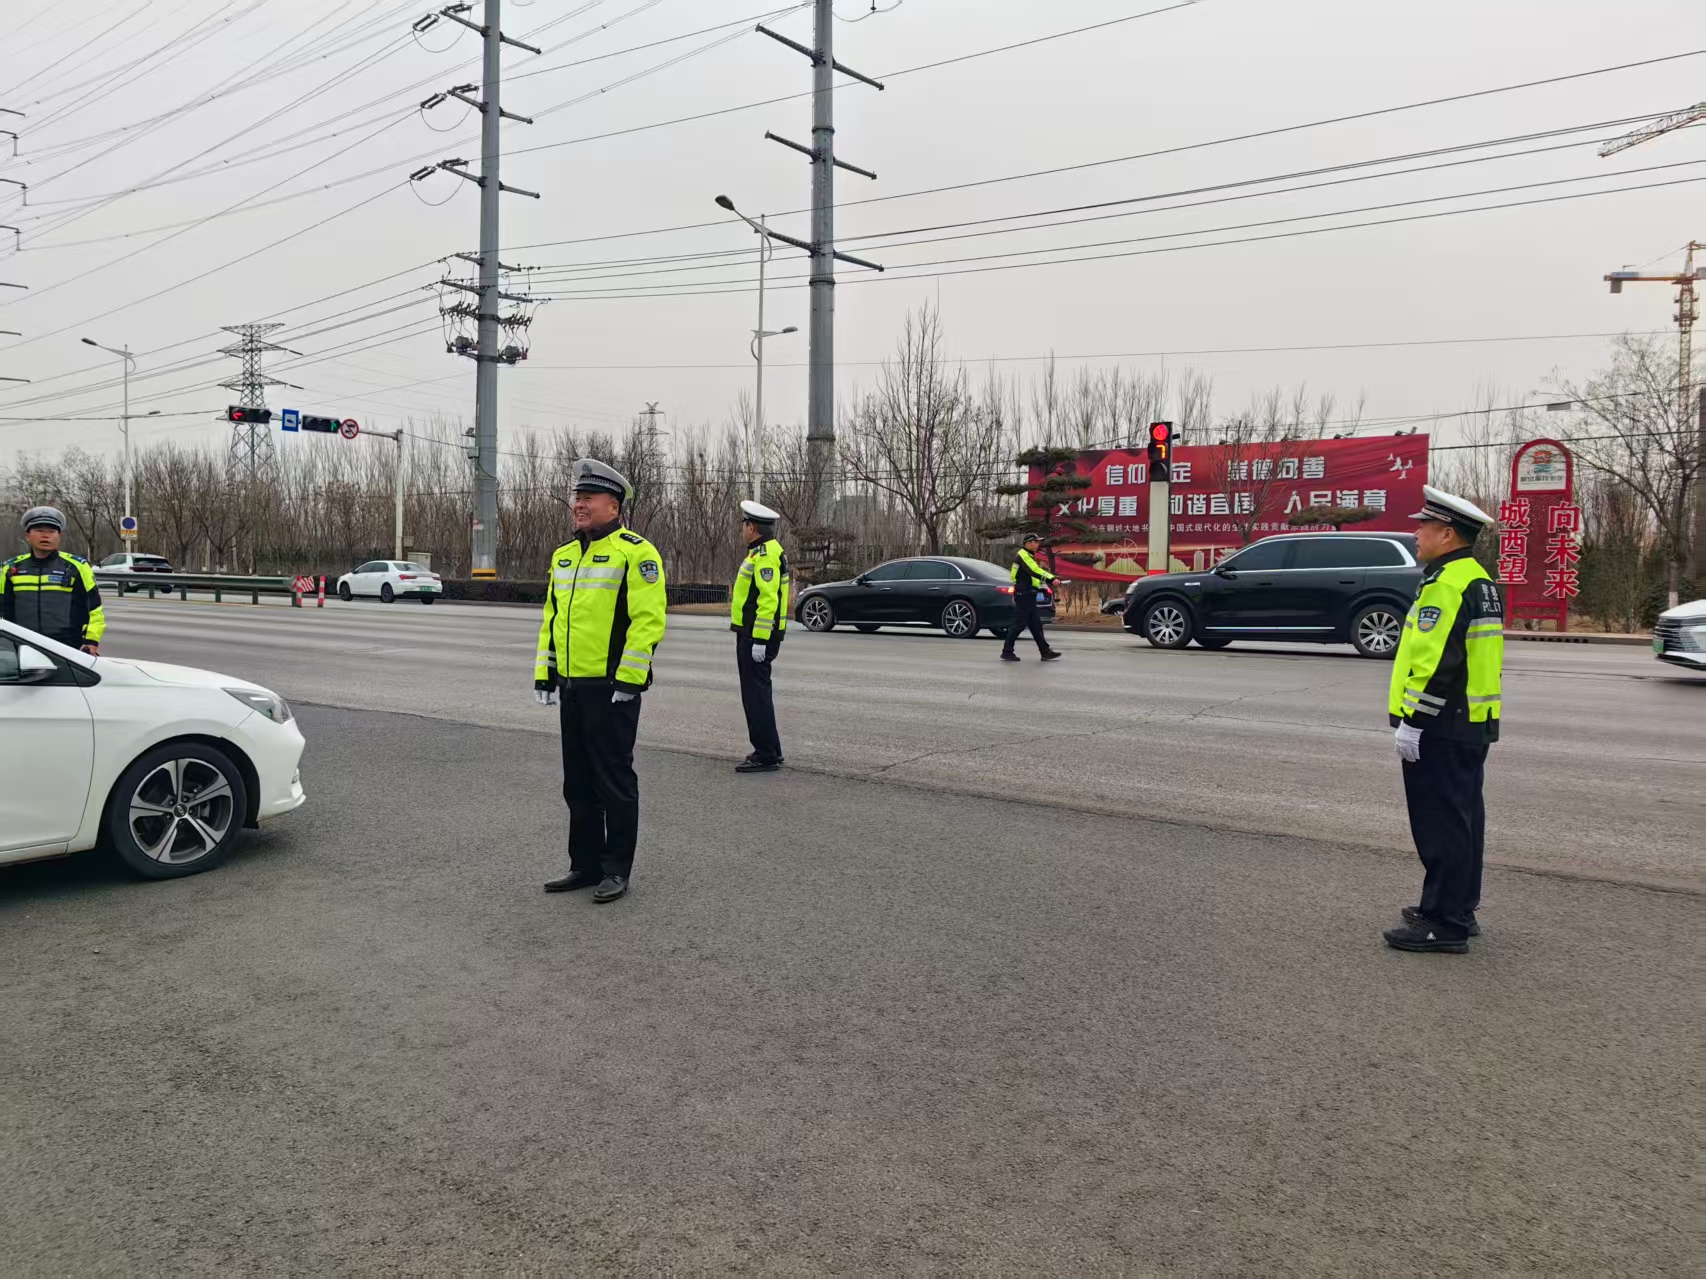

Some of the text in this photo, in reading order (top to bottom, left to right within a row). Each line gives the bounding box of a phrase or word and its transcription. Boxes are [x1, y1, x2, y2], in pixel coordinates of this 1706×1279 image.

[1105, 462, 1192, 486] 信仰定
[1156, 444, 1166, 459] 7
[1496, 498, 1530, 585] 城西望
[1543, 500, 1581, 599] 向未来
